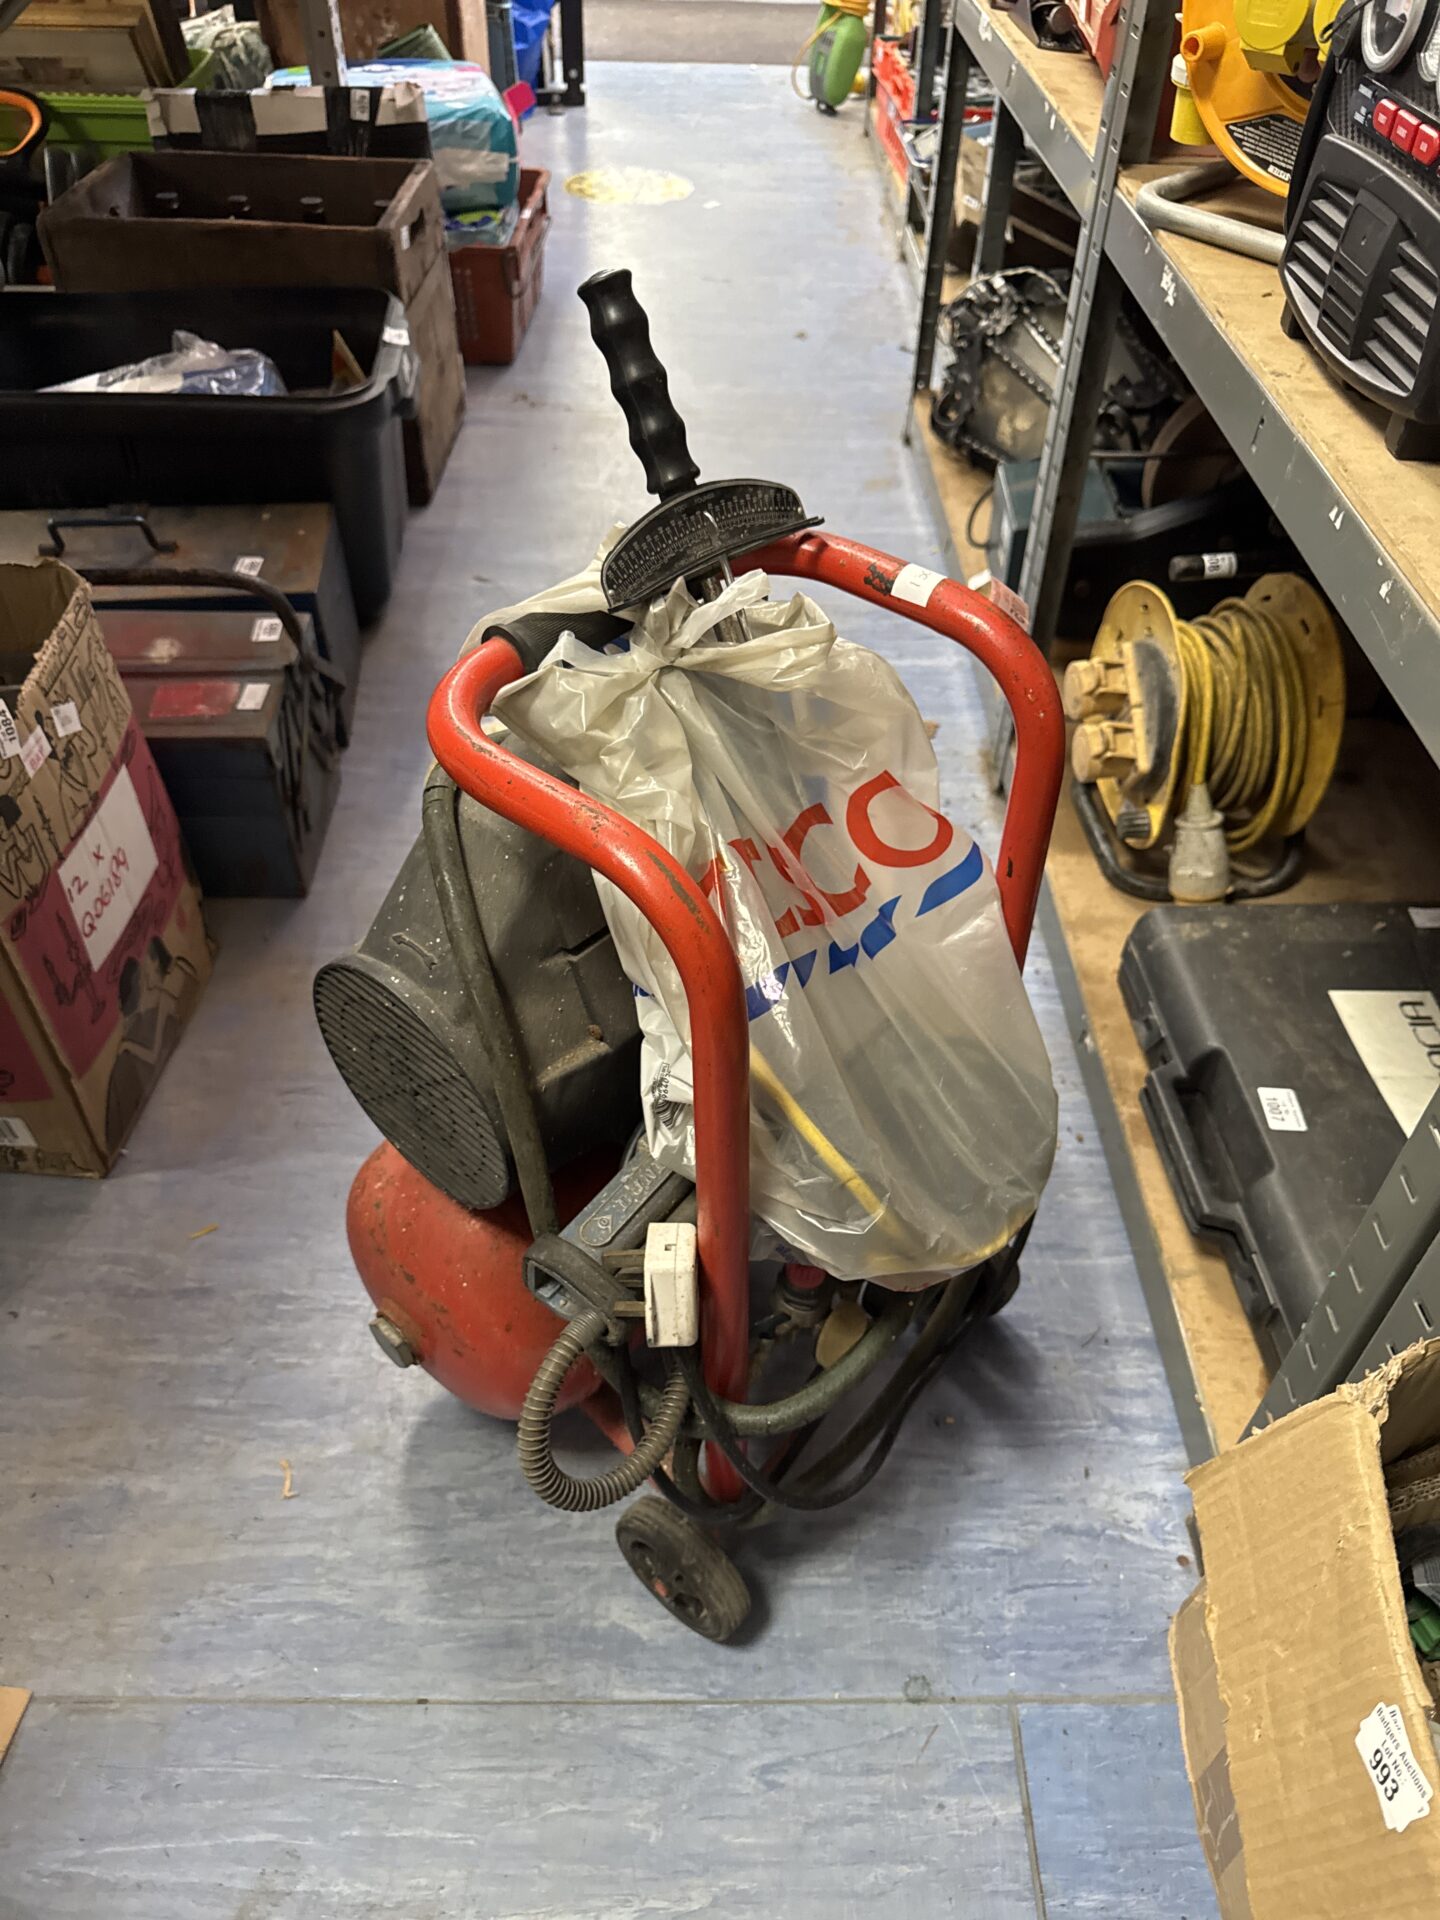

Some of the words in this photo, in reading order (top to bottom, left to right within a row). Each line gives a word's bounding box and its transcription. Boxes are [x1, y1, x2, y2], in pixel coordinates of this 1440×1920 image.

[1369, 1748, 1400, 1802] 993
[1376, 1706, 1401, 1751] Badgers
[1399, 1751, 1428, 1799] Auctions
[1381, 1739, 1393, 1760] Lot
